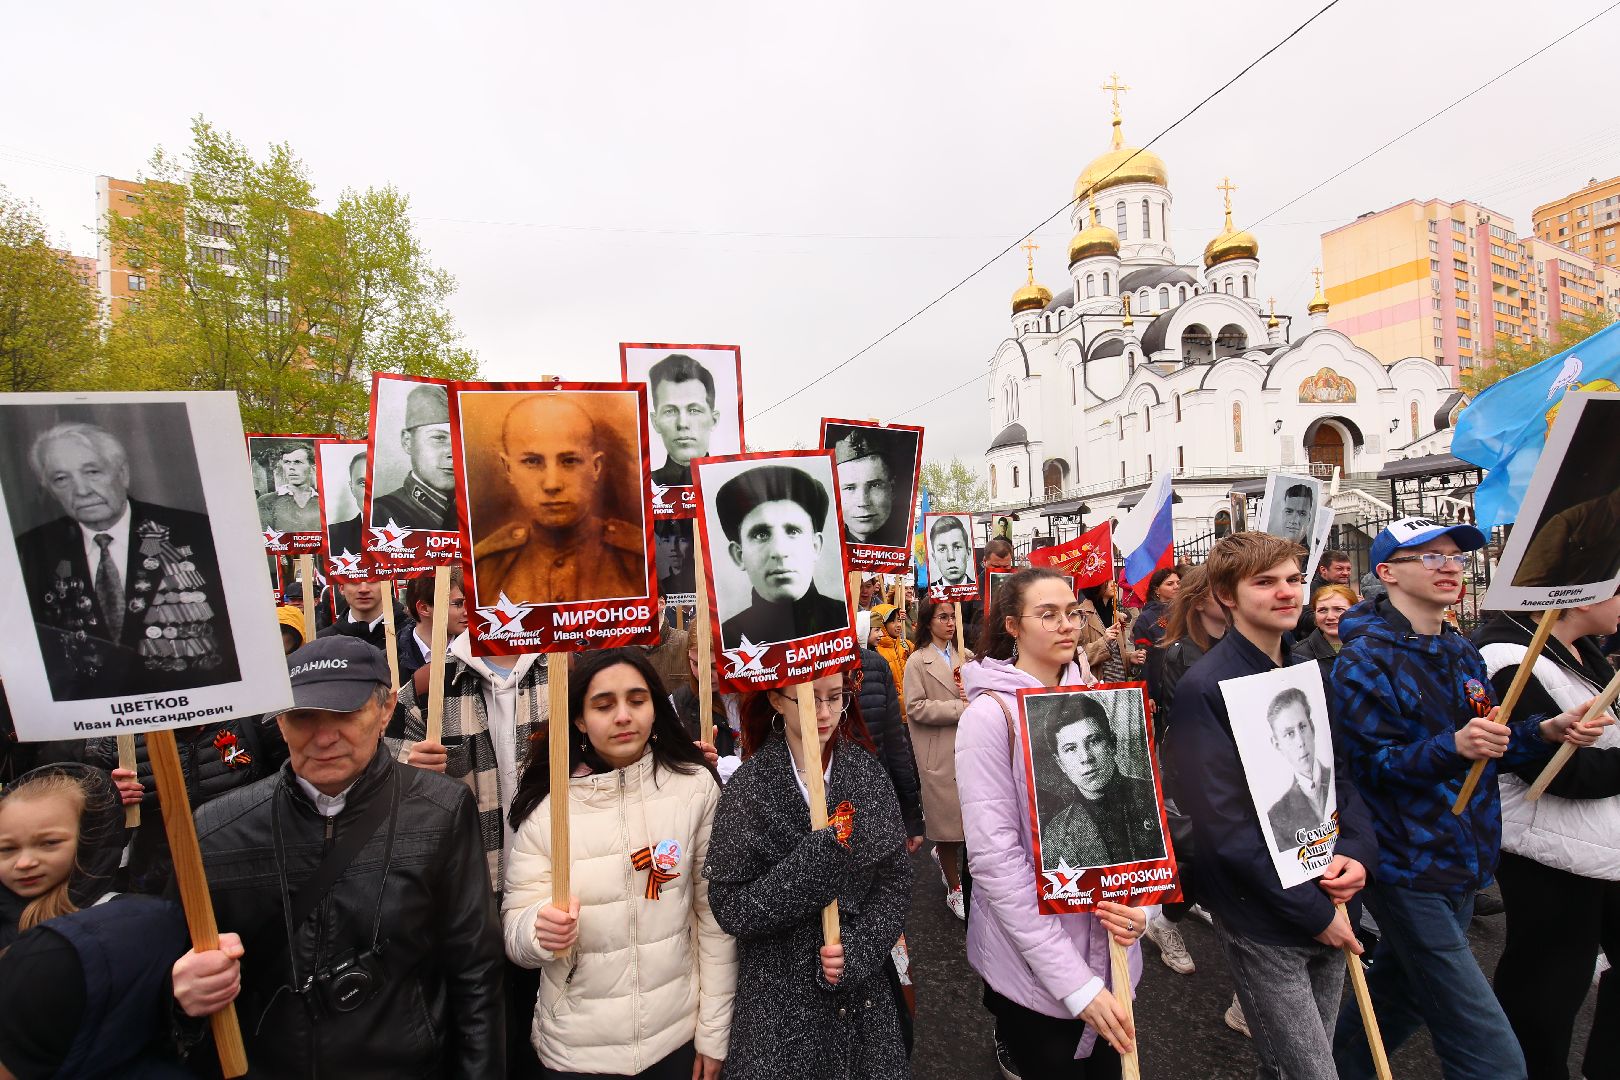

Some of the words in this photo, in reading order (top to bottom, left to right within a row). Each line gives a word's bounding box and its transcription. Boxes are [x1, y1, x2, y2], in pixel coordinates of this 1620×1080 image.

[426, 536, 462, 549] ЮРЧ
[852, 548, 906, 561] ЧЕРНИКОВ
[1520, 598, 1555, 607] Алексей
[1555, 595, 1597, 606] Васильевич
[1548, 587, 1584, 598] СВИРИН
[552, 605, 651, 627] МИРОНОВ
[553, 628, 585, 641] Иван
[585, 624, 652, 640] Федорович
[509, 636, 542, 647] полк
[785, 636, 854, 664] БАРИНОВ
[290, 658, 349, 678] BRAHMOS
[787, 664, 813, 677] Иван
[813, 652, 856, 671] Климович
[751, 673, 779, 684] полк
[110, 695, 190, 715] ЦВЕТКОВ
[73, 719, 112, 732] Иван
[114, 704, 234, 728] Александрович
[1100, 866, 1173, 888] МОРОЗКИН
[1102, 889, 1129, 899] Виктор
[1129, 882, 1176, 897] Дмитриевич
[1067, 896, 1094, 906] полк
